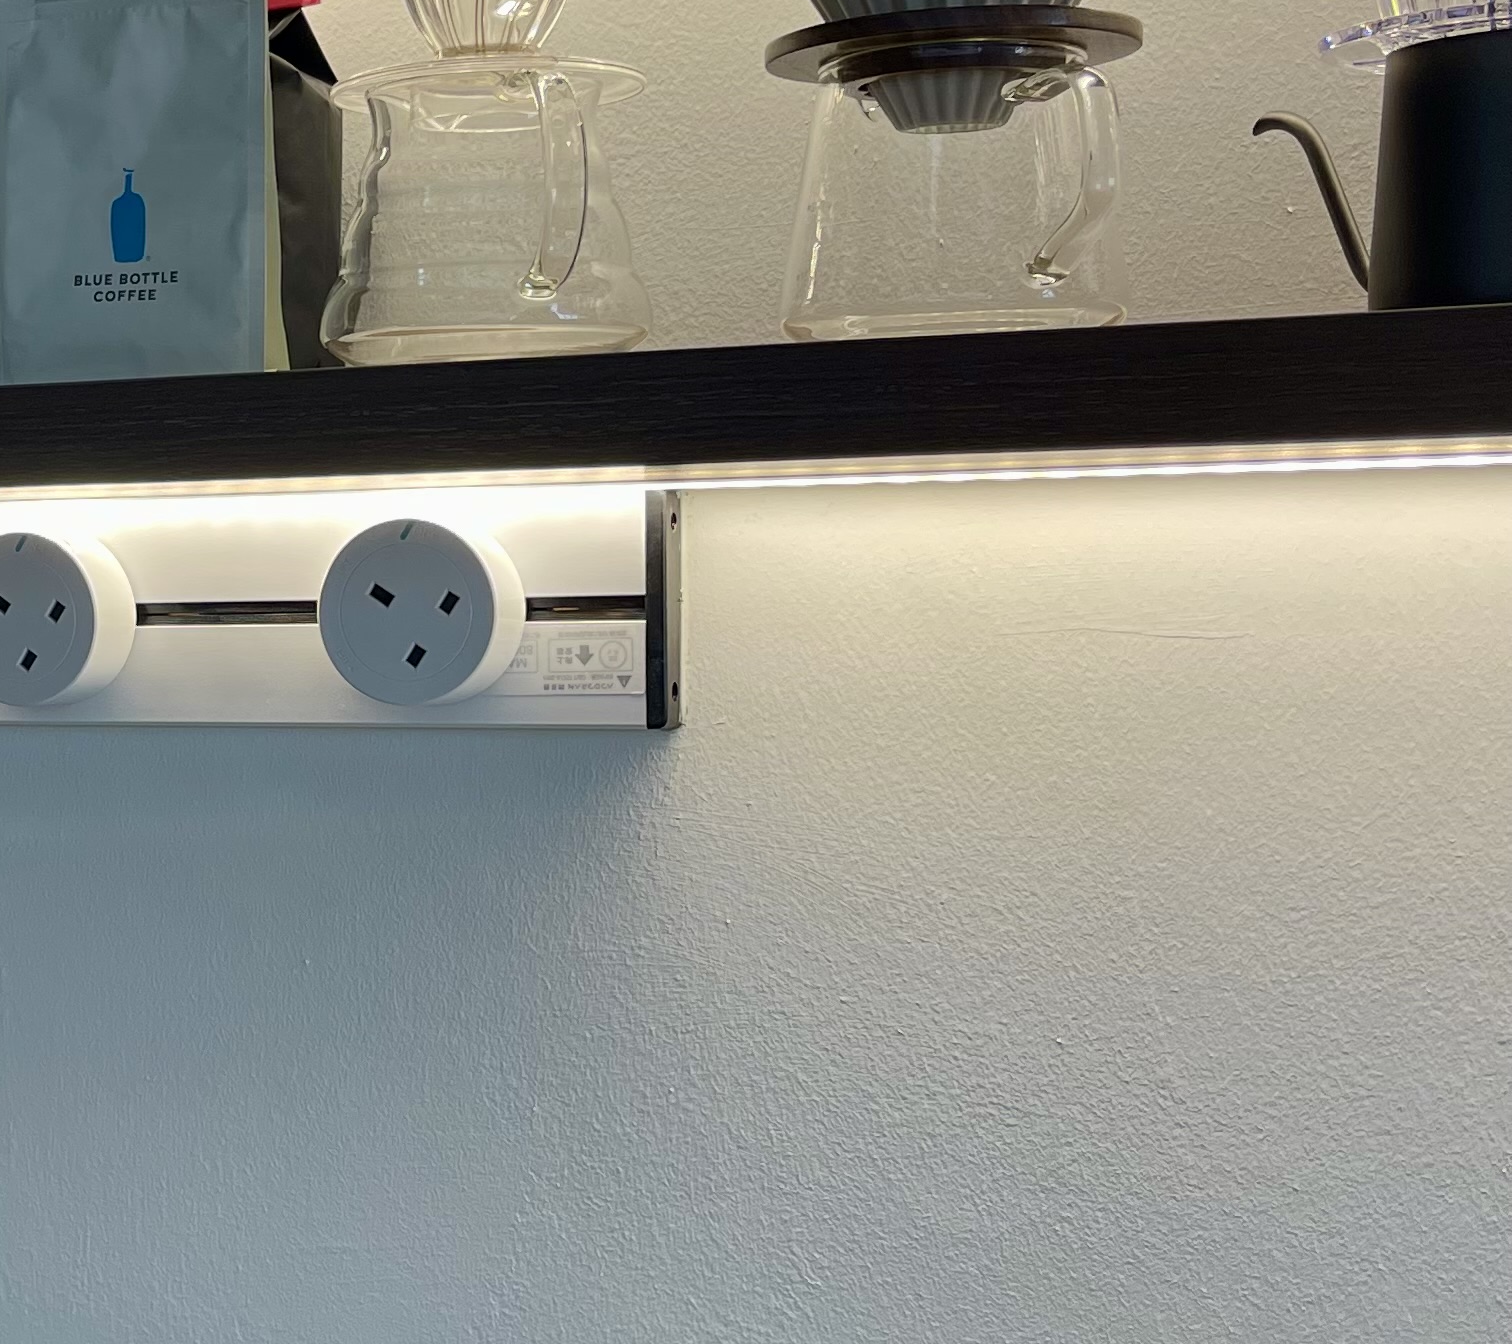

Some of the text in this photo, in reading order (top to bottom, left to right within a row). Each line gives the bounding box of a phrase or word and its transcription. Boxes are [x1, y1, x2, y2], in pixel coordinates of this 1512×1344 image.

[73, 270, 179, 287] BLUE BOTTLE
[93, 289, 157, 303] COFFEE
